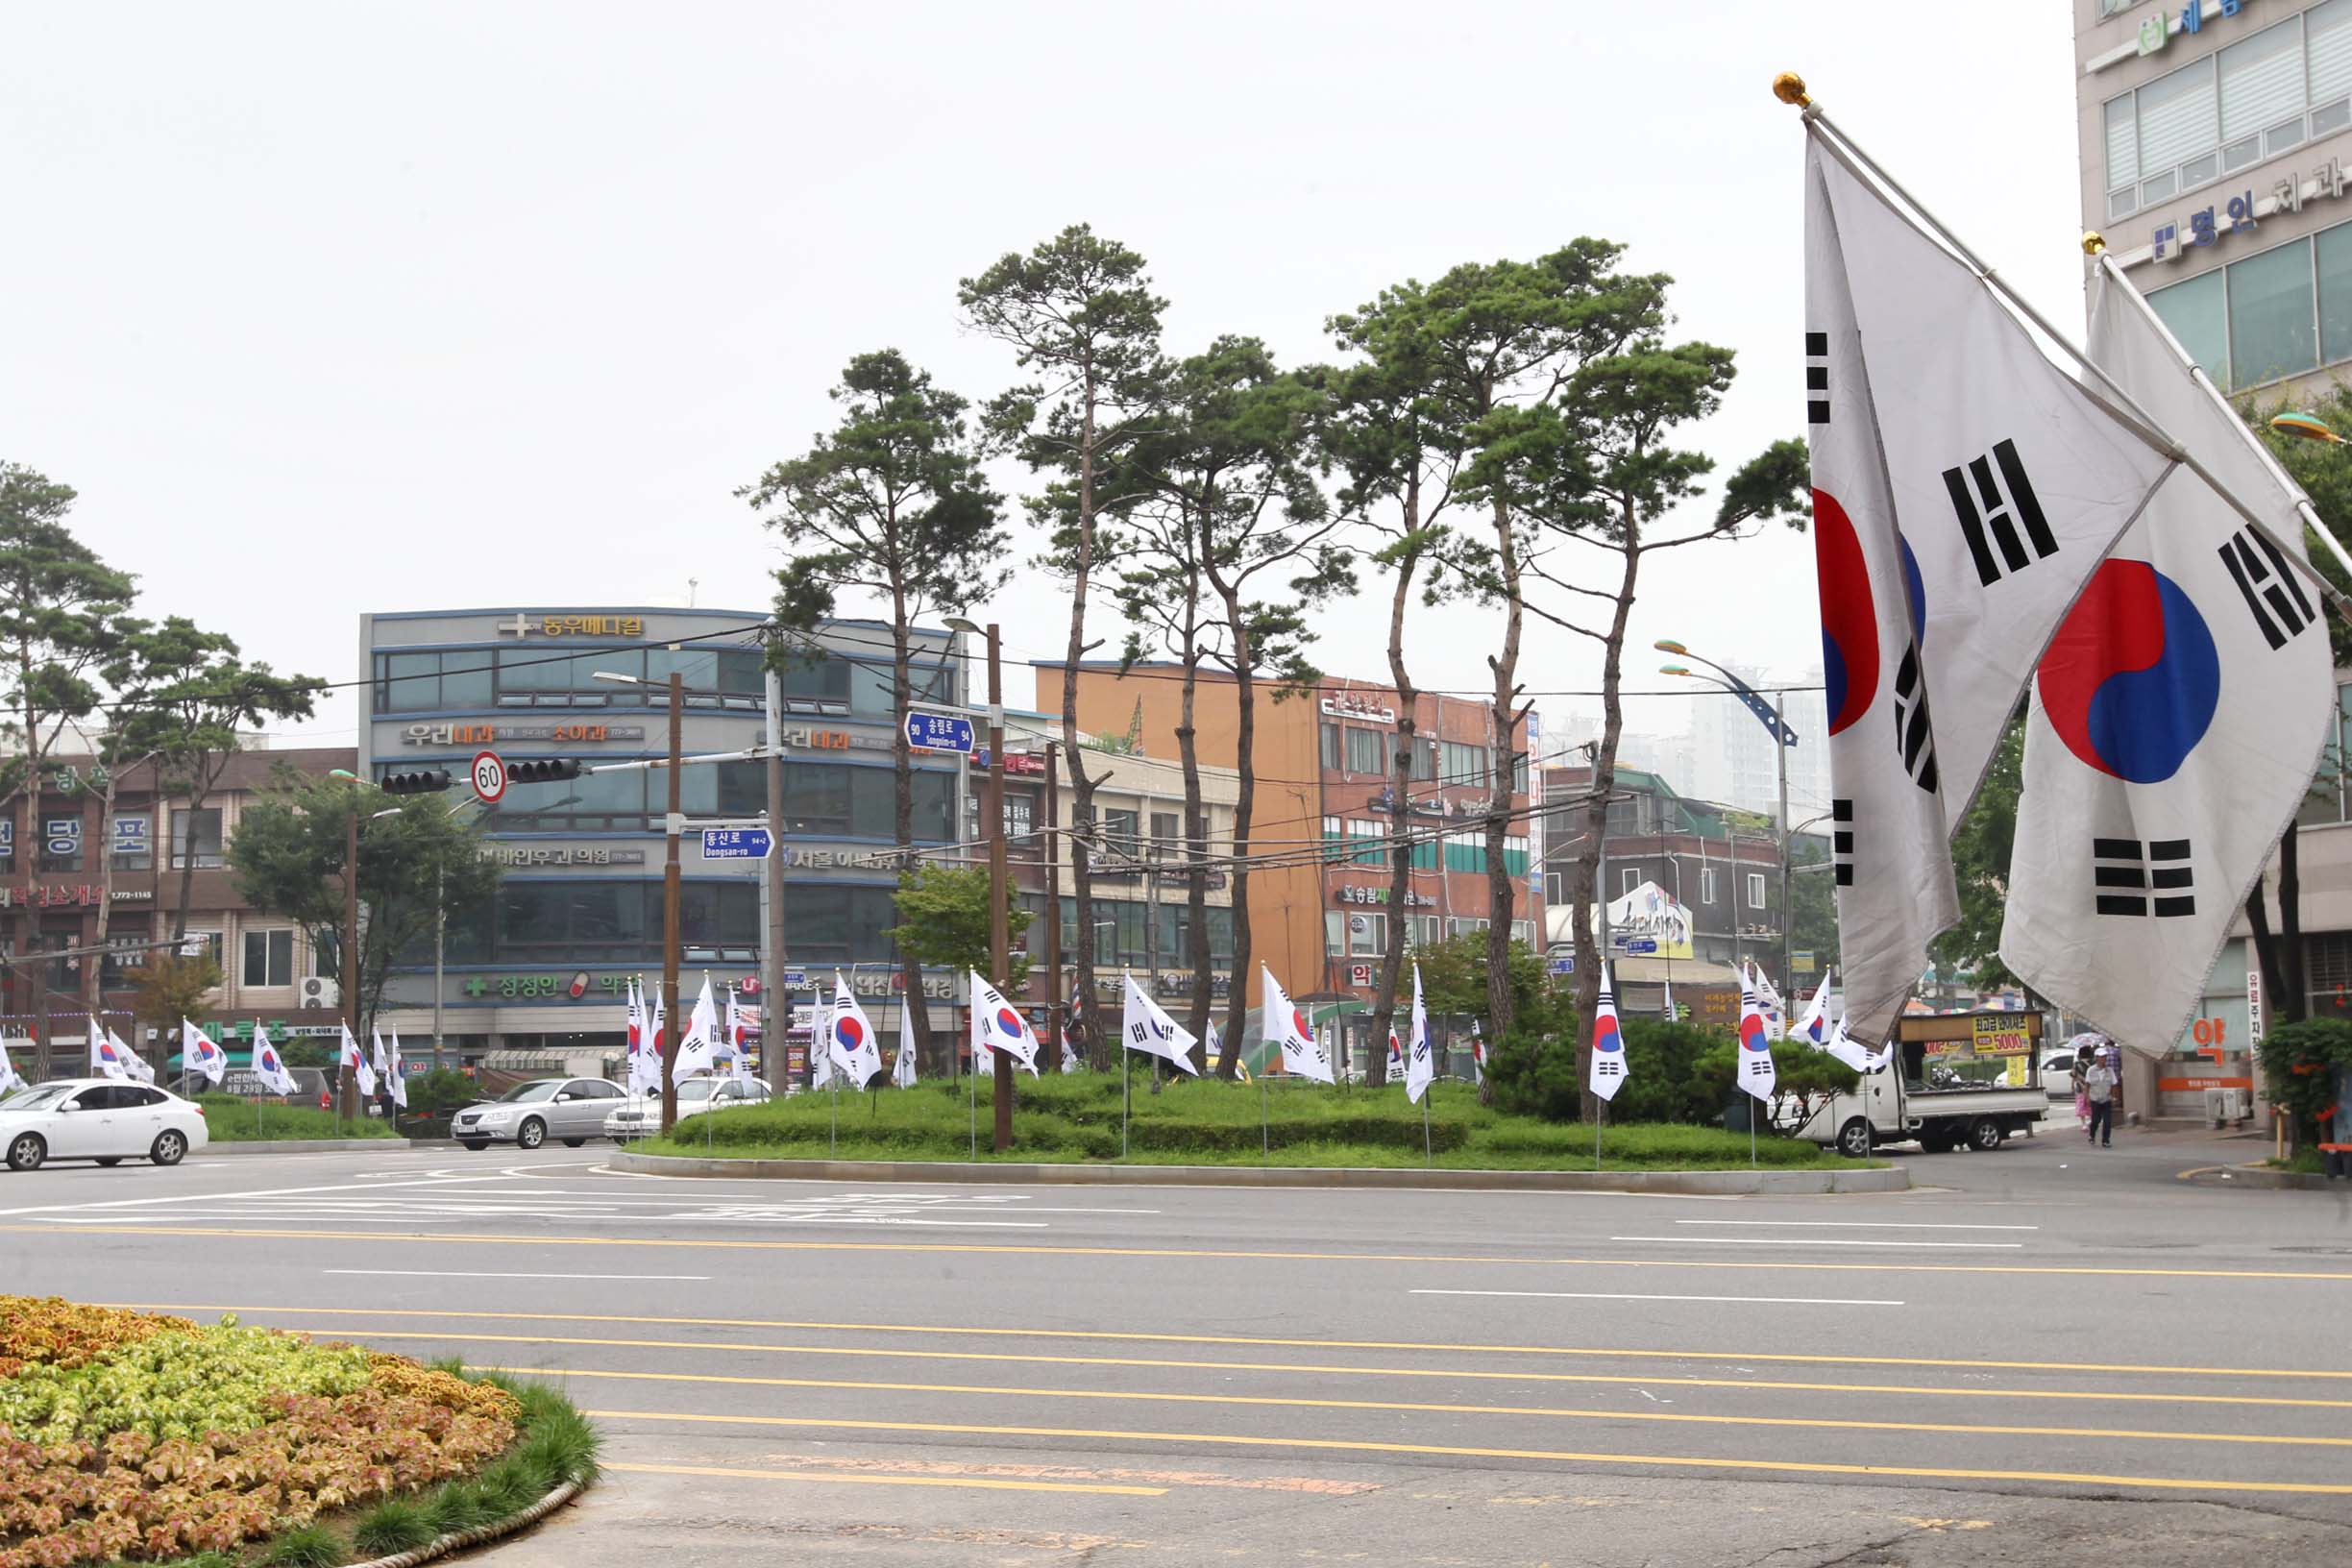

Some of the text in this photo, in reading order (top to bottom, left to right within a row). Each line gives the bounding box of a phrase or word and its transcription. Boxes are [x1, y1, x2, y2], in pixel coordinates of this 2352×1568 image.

[544, 615, 643, 636] 동우메디컬
[407, 723, 495, 746] 우리내과
[551, 723, 608, 743] 소아과
[928, 718, 953, 735] 송림로
[961, 730, 969, 742] 94
[783, 727, 849, 750] 리내과
[478, 765, 499, 789] 60
[707, 832, 740, 845] 동산로
[705, 847, 748, 857] Dongsan-ro
[794, 850, 832, 869] 서울
[1353, 965, 1371, 985] 약
[2249, 974, 2259, 1003] 유료
[1975, 1018, 1997, 1032] 최고급
[2193, 1018, 2225, 1067] 약
